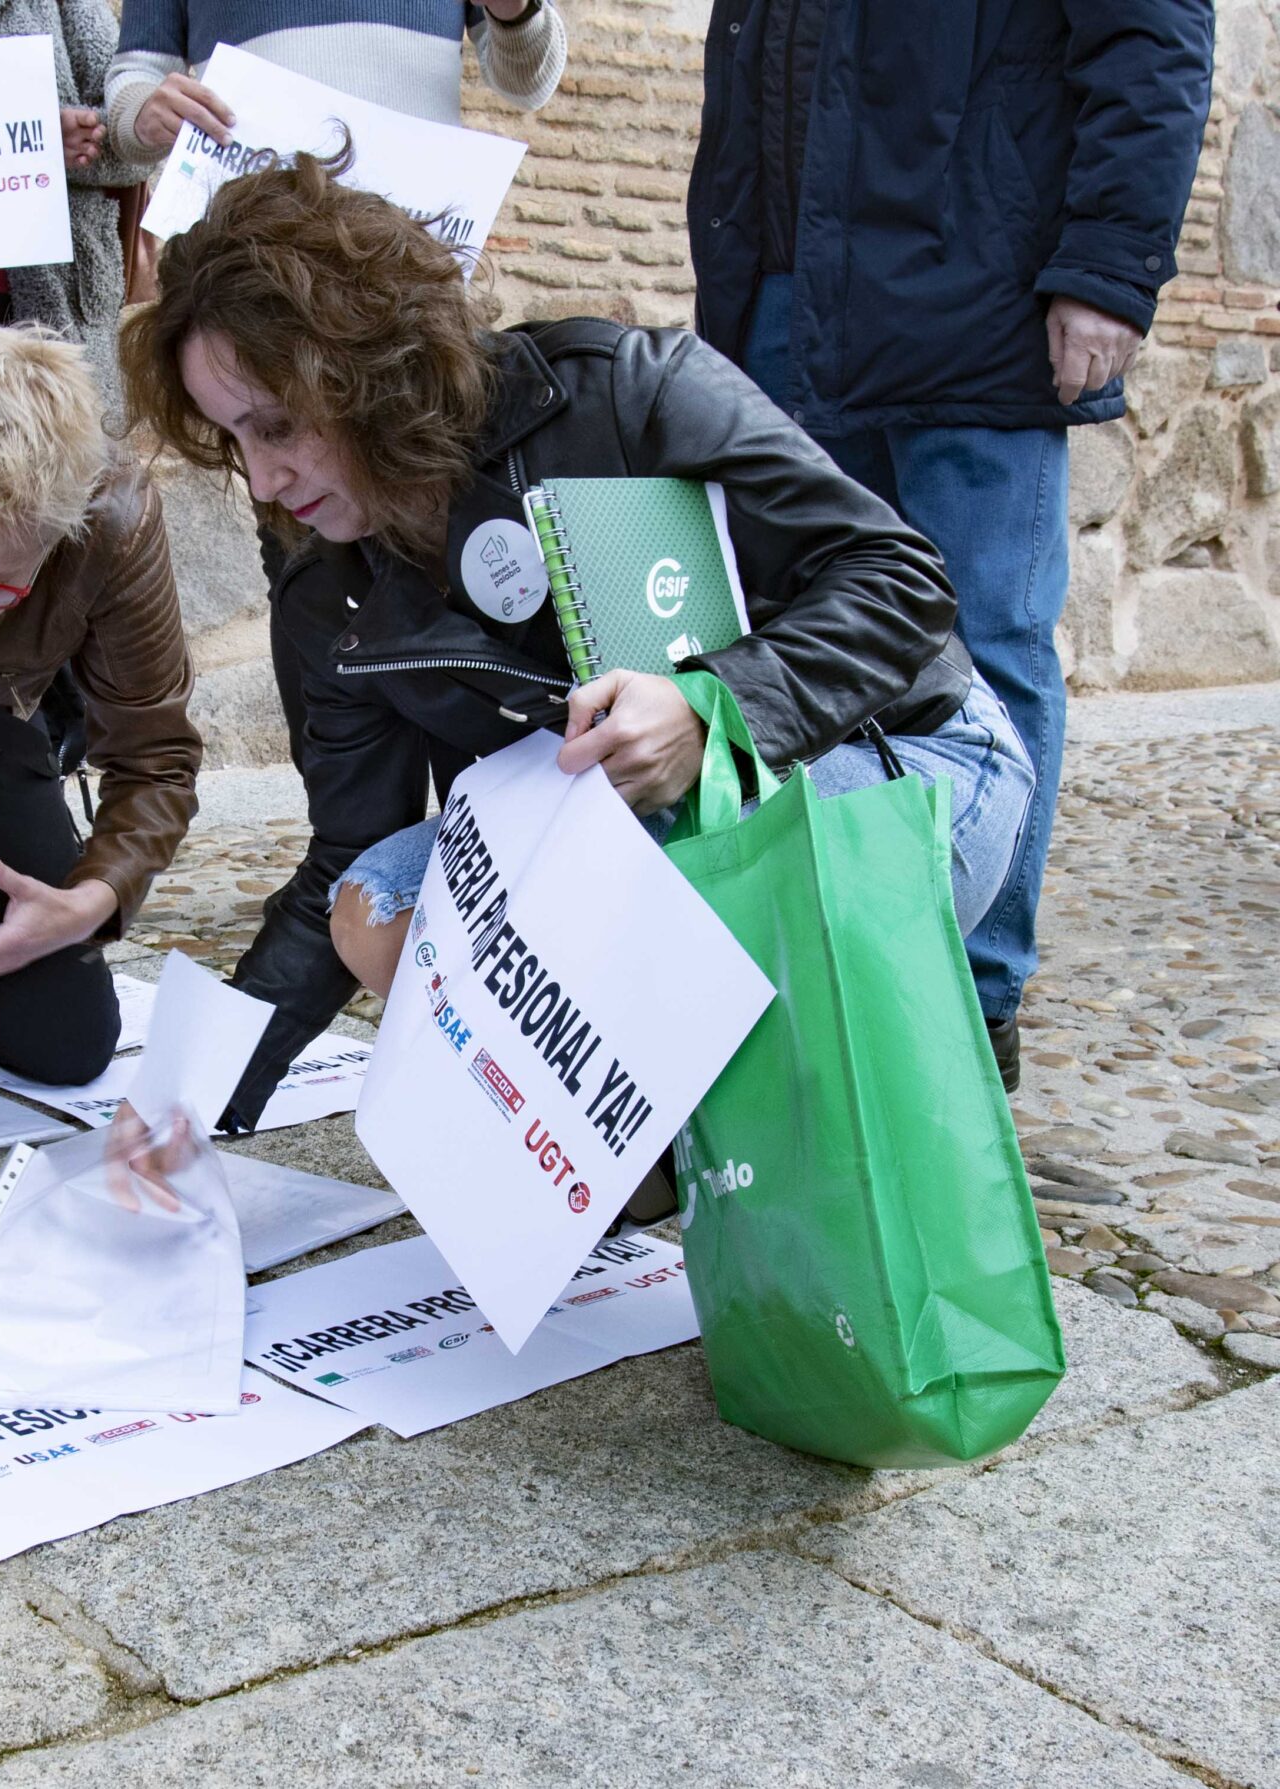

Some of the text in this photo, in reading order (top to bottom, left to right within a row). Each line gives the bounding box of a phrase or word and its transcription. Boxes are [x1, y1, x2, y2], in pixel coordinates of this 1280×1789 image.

[5, 119, 45, 155] YA!!
[494, 566, 522, 589] palabra
[654, 574, 690, 600] CSIF
[584, 1057, 654, 1159] YA!!
[486, 1063, 514, 1099] CCOO
[524, 1118, 576, 1187] UGT
[624, 1267, 679, 1289] UGT
[260, 1309, 429, 1374] ¡¡CARRERA
[103, 1423, 138, 1439] CCOO
